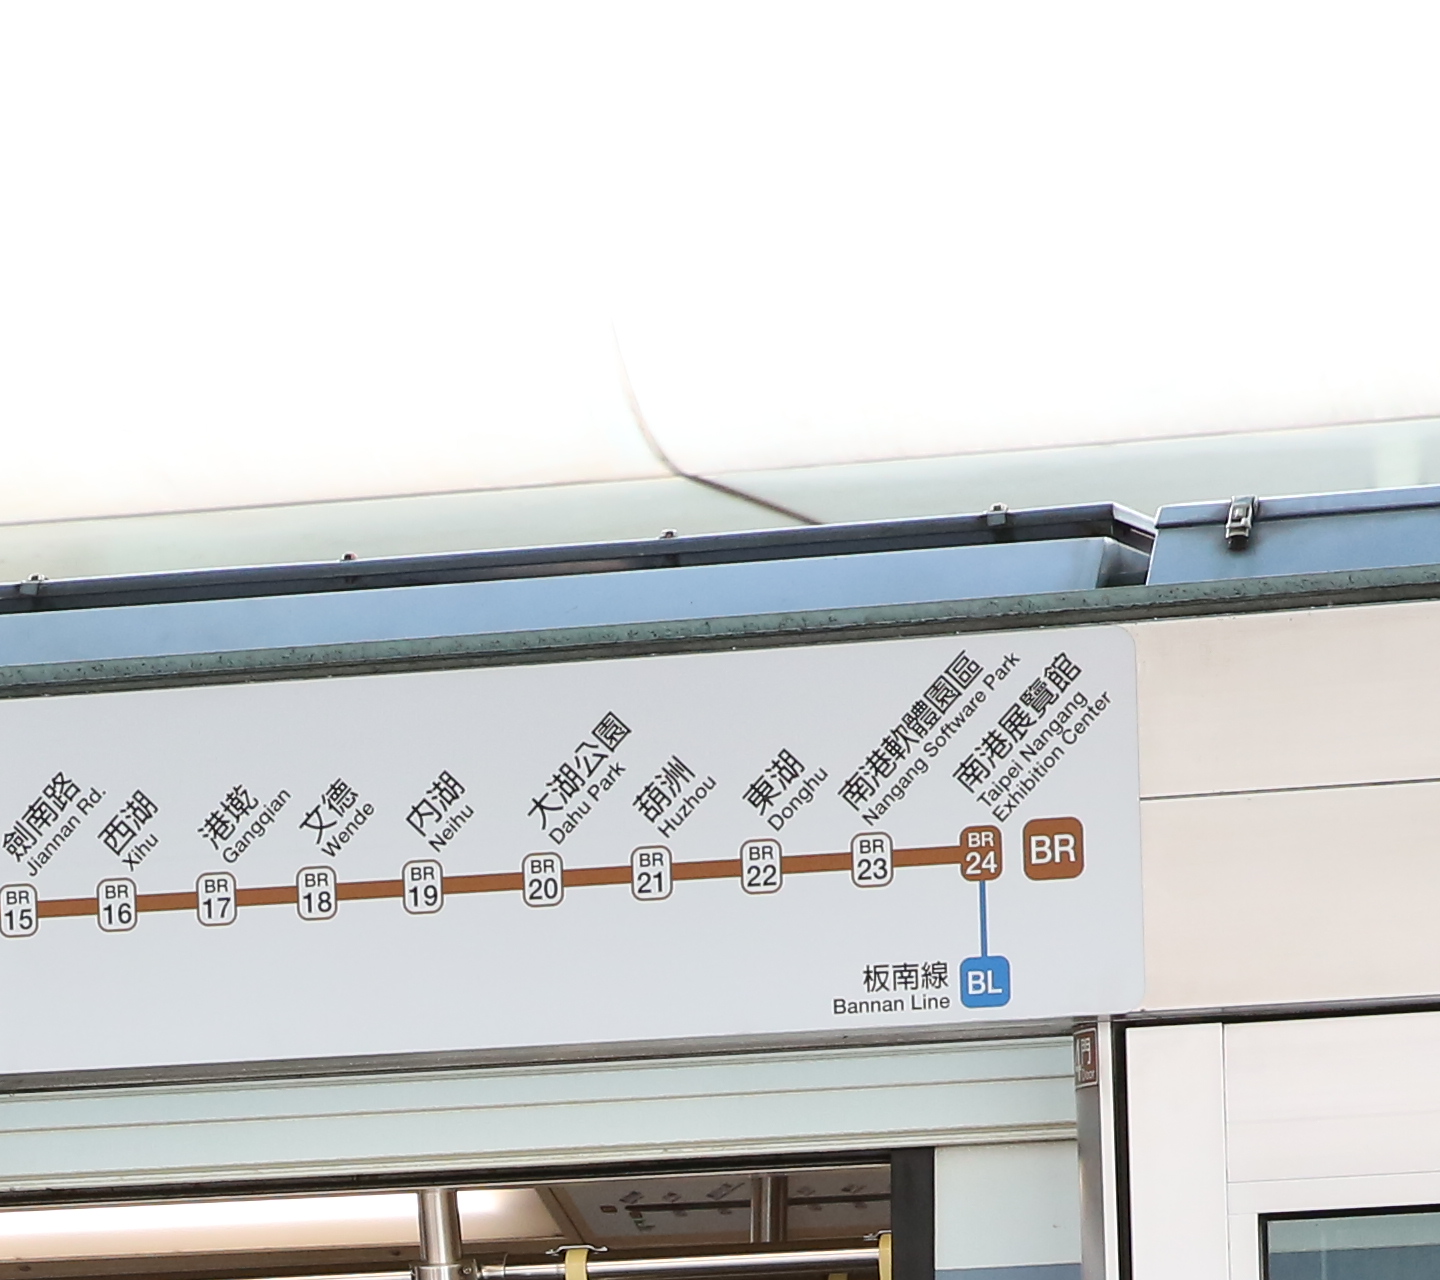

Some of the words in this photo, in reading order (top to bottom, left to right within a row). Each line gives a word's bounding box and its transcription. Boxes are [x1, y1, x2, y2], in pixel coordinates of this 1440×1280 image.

[836, 649, 984, 812] 南港軟體園區
[860, 756, 929, 822] Nangang
[922, 689, 987, 758] Software
[981, 651, 1021, 691] Park
[951, 651, 1082, 794] 南港展覽館
[975, 757, 1024, 807] Taipei
[1018, 690, 1088, 764] Nangang
[991, 745, 1065, 823] Exhibition
[1060, 690, 1111, 745] Center
[526, 710, 632, 830] 大湖公園
[547, 800, 592, 845] Dahu
[585, 760, 626, 802] Park
[631, 753, 696, 824] 葫洲
[741, 747, 806, 816] 東湖
[766, 766, 829, 828] Donghu
[1, 770, 81, 863] 劍南路
[25, 814, 81, 877] Jiannan
[75, 786, 107, 816] Rd.
[96, 788, 159, 857] 西湖
[196, 783, 259, 851] 港墘
[221, 788, 291, 860] Gangqian
[297, 776, 359, 845] 文德
[319, 802, 375, 854] Wende
[427, 803, 474, 853] Neihu
[656, 775, 717, 836] Huzhou
[120, 832, 159, 868] Xihu
[857, 857, 888, 881] 23
[965, 850, 998, 875] 24
[1032, 835, 1076, 864] BR
[408, 884, 438, 908] 19
[833, 998, 906, 1015] Bannan
[912, 995, 951, 1011] Line
[862, 963, 949, 993] 板南線
[967, 970, 1003, 995] BL
